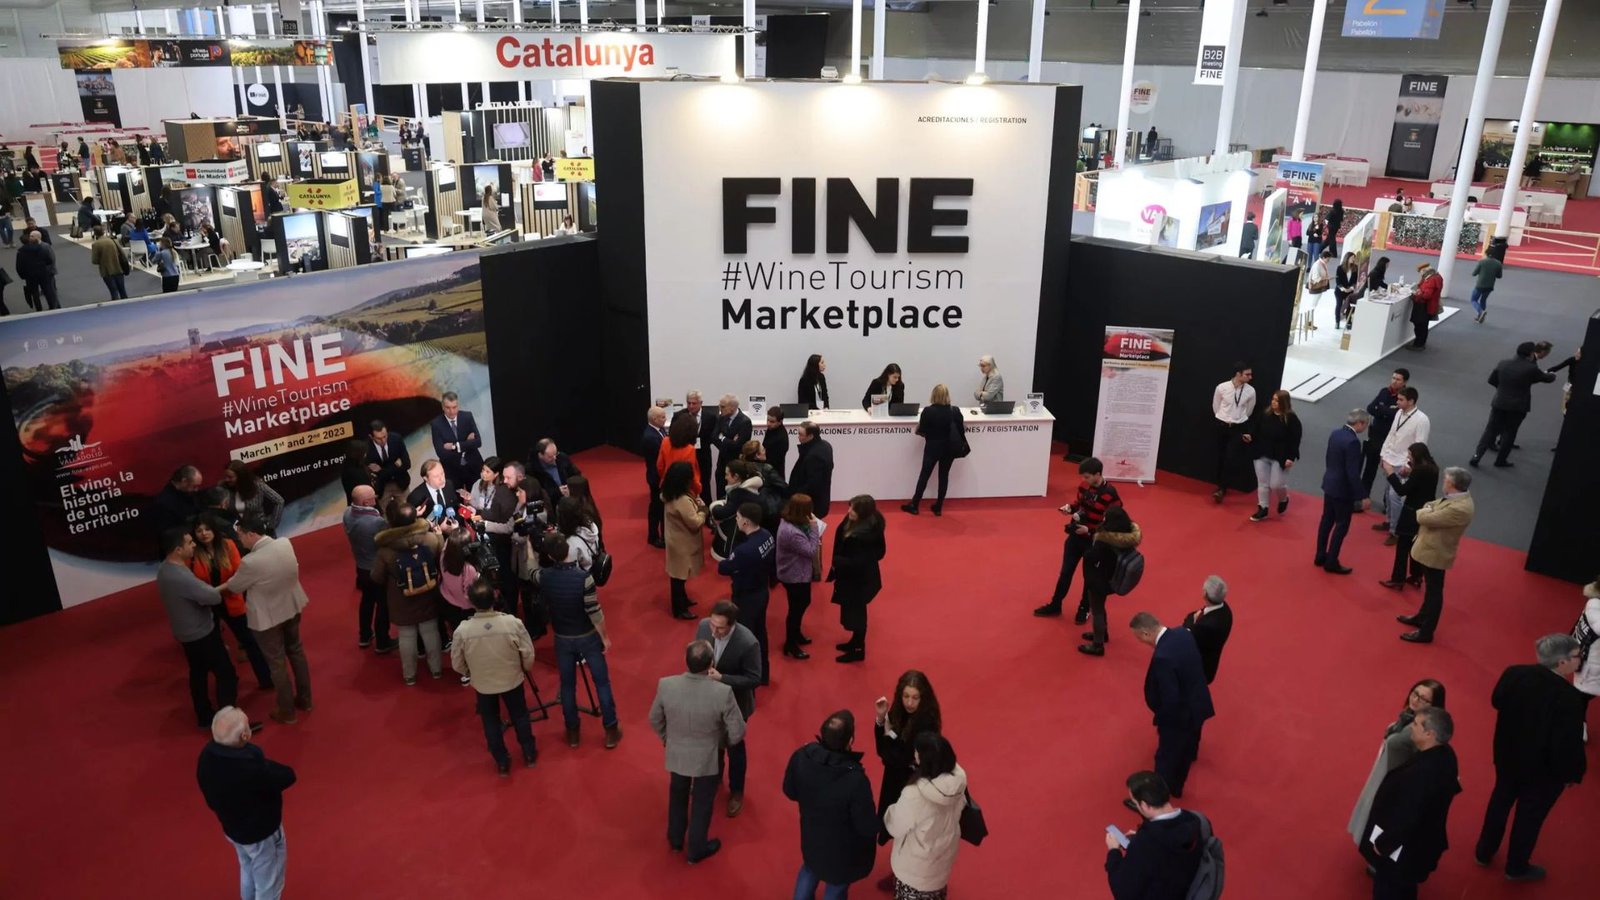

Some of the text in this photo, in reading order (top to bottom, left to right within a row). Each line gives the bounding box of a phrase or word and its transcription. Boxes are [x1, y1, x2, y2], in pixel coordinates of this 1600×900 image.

[496, 36, 654, 72] Catalunya
[1203, 49, 1223, 60] B2B
[1200, 70, 1223, 79] FINE
[1133, 87, 1151, 95] FINE
[1409, 81, 1438, 92] FINE
[917, 116, 974, 124] ACREDITACIONES
[1291, 170, 1317, 181] FINE
[722, 177, 974, 255] FINE
[722, 261, 964, 291] #WineTourism
[722, 298, 963, 337] Marketplace
[1120, 337, 1152, 350] FINE
[211, 332, 347, 398] FINE
[222, 379, 349, 418] #WineTourism
[224, 398, 351, 438] Marketplace
[987, 425, 1040, 433] REGISTRATION
[858, 427, 912, 436] REGISTRATION
[240, 445, 272, 460] March
[287, 437, 306, 449] and
[322, 427, 346, 441] 2023
[60, 450, 103, 465] VALLADOLID
[264, 472, 279, 482] the
[280, 462, 311, 478] flavour
[313, 459, 322, 470] of
[323, 459, 329, 467] a
[60, 471, 134, 498] El vino, la
[63, 487, 122, 510] historia
[66, 503, 109, 523] de un
[69, 507, 140, 535] territorio
